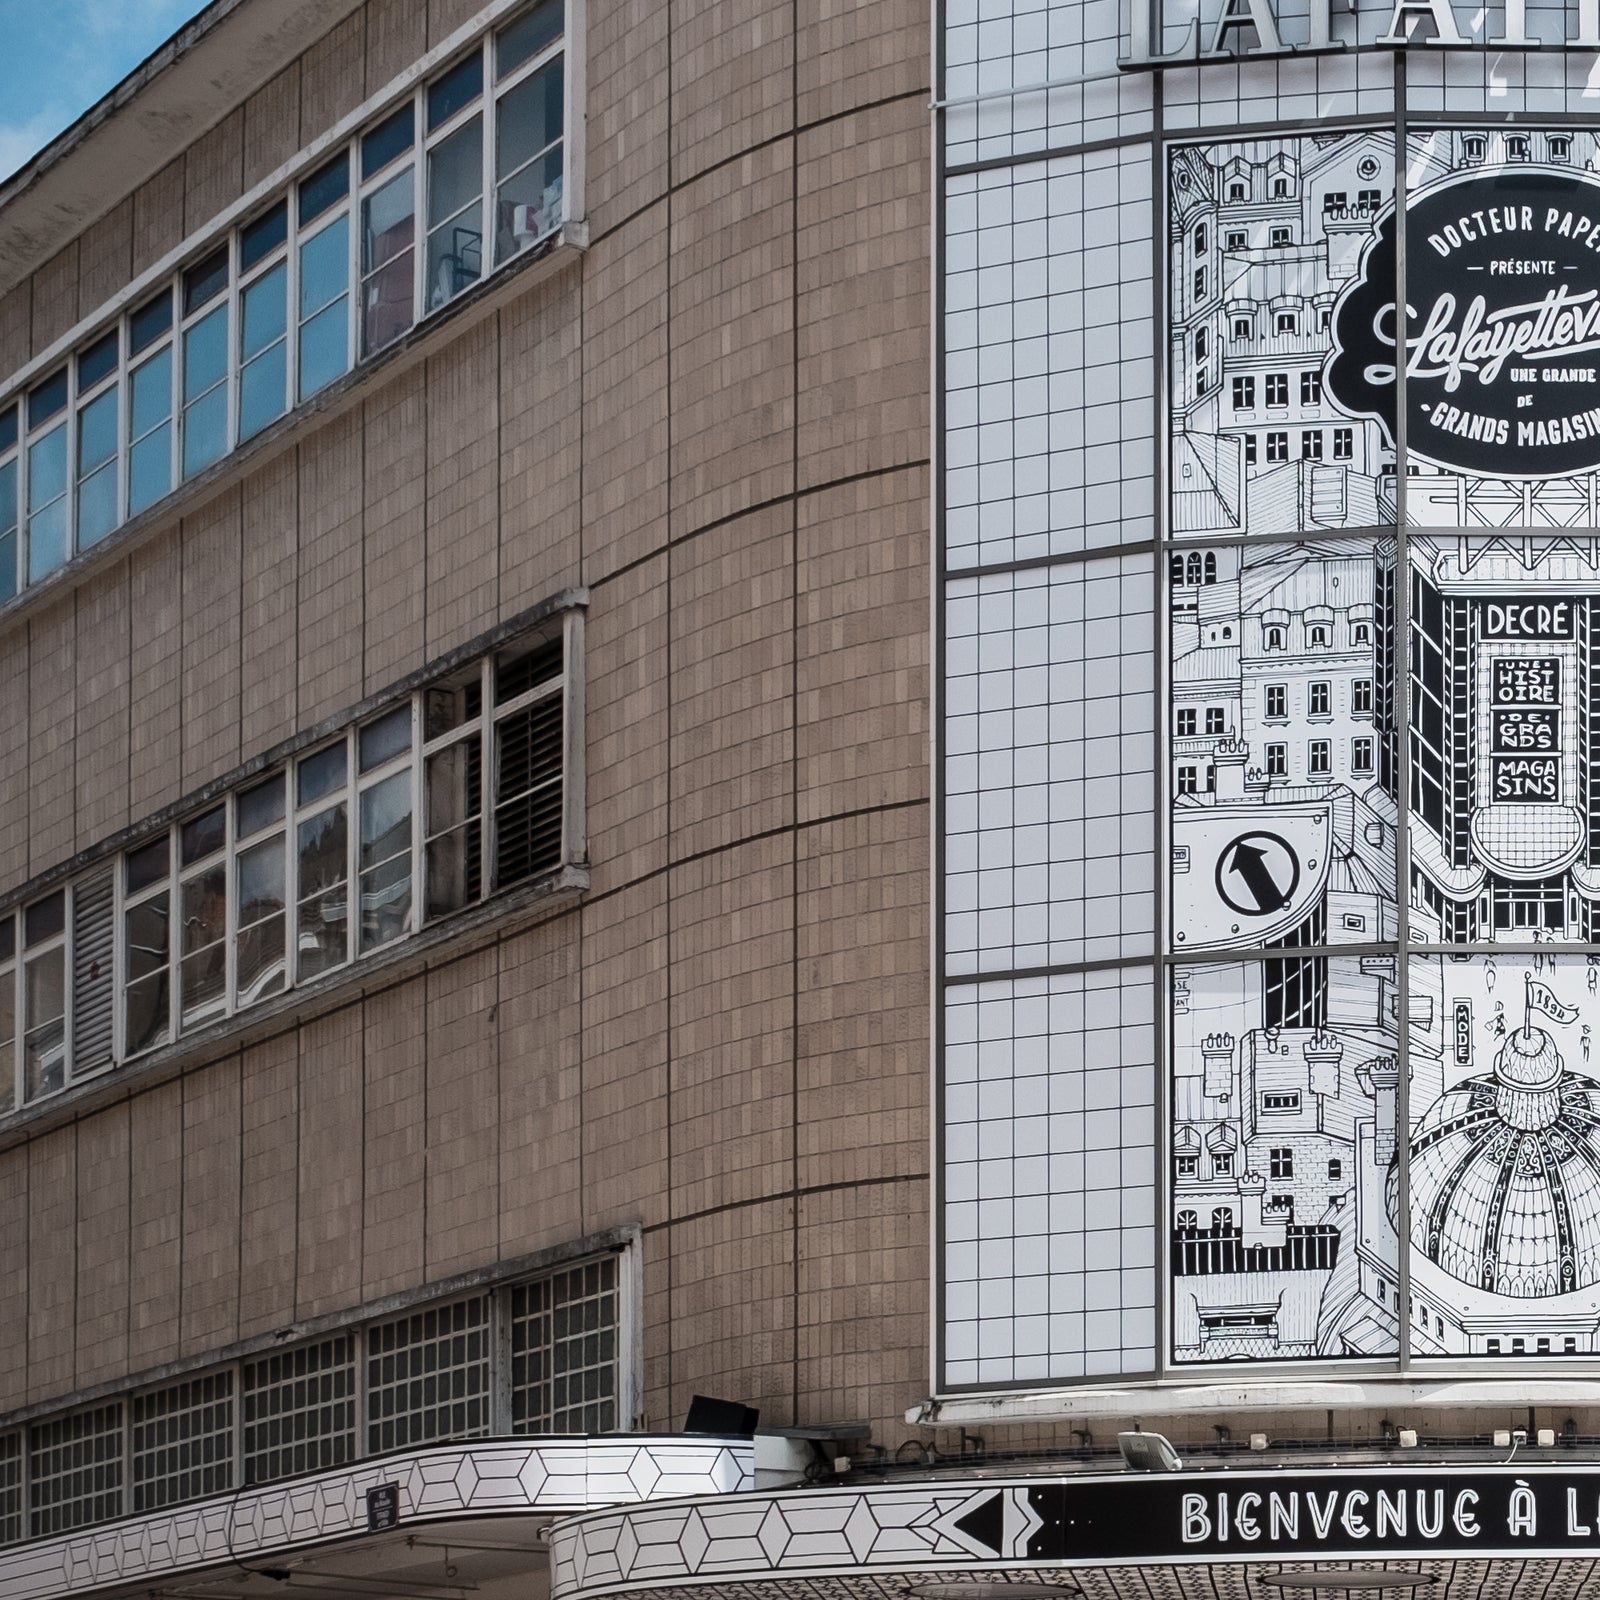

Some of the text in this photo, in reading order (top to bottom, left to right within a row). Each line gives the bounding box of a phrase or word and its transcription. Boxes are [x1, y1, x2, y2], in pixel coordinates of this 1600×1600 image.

[1427, 205, 1534, 258] DOCTEUR
[1489, 257, 1557, 276] PRÉSENTE
[1510, 368, 1538, 383] UNE
[1542, 368, 1597, 384] GRANDE
[1517, 394, 1534, 408] DE
[1429, 402, 1508, 446] GRANDS
[1486, 602, 1569, 636] DECRÉ
[1505, 660, 1542, 669] UNE
[1498, 669, 1555, 686] HIST
[1497, 686, 1555, 704] OIRE
[1508, 712, 1543, 723] DE
[1499, 722, 1553, 737] GRA
[1500, 735, 1553, 749] NDS
[1497, 760, 1556, 776] MAGA
[1496, 775, 1557, 797] SINS
[1535, 989, 1566, 1020] 1894
[1456, 1012, 1469, 1058] MODE
[1180, 1487, 1482, 1543] BIENVENUE
[1505, 1478, 1538, 1538] À
